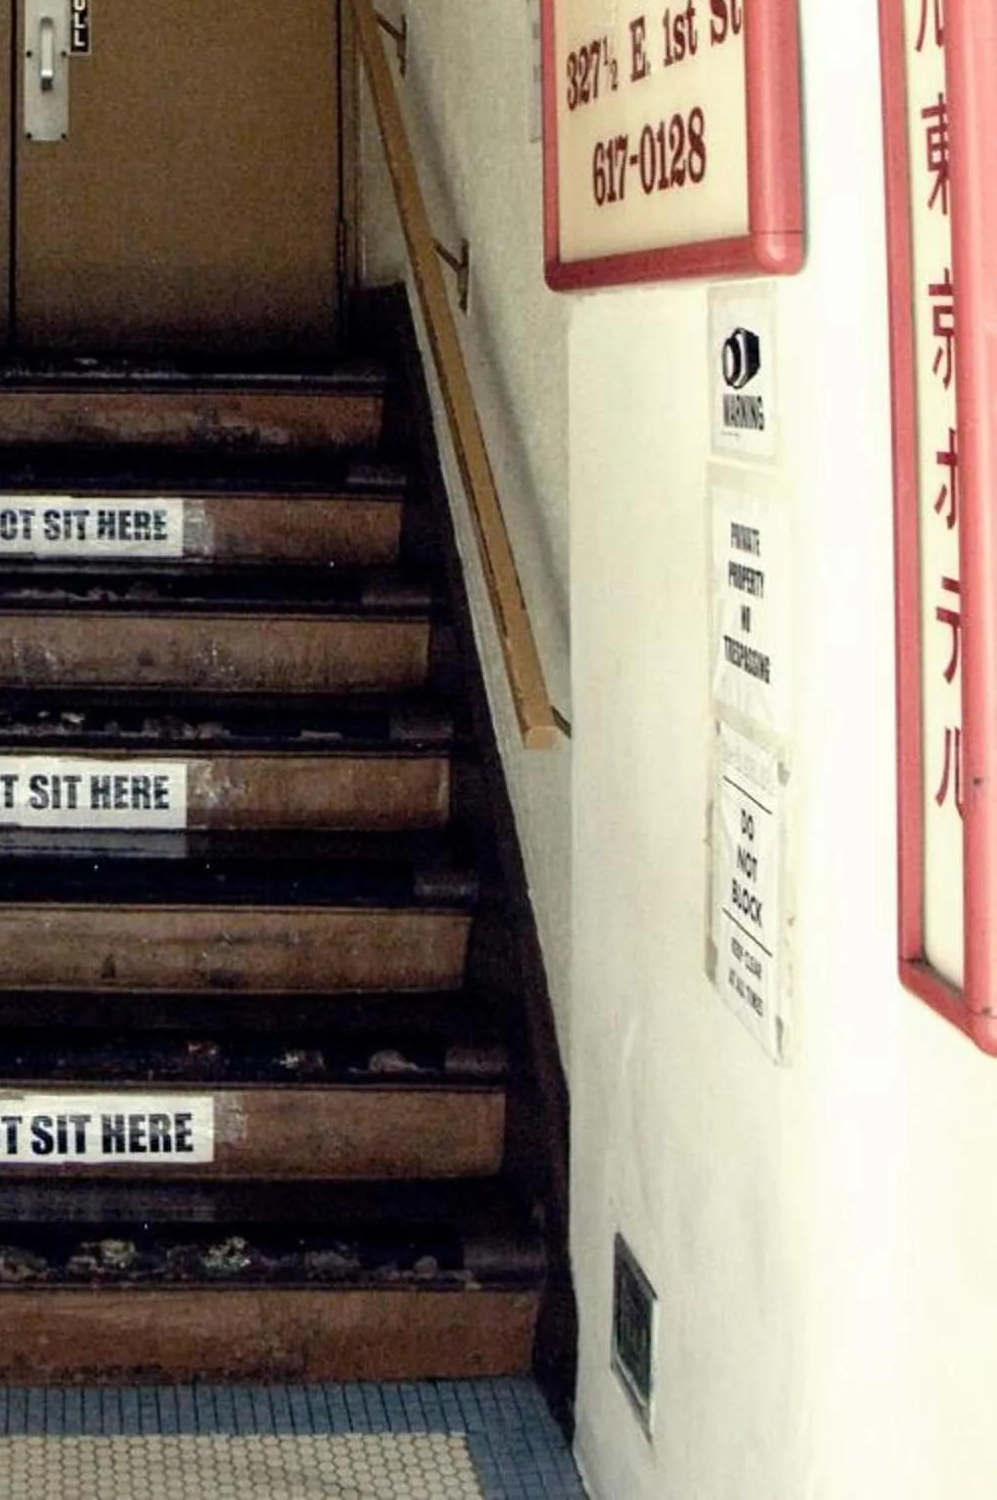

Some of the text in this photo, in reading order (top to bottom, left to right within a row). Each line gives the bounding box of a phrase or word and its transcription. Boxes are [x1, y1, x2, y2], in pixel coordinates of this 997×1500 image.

[592, 105, 707, 207] 617-0128
[723, 393, 765, 431] WARNING
[43, 509, 91, 541] SIT
[97, 510, 169, 541] HERE
[728, 560, 764, 599] PROPERTY
[723, 633, 771, 685] TRESPASSING
[29, 774, 82, 810] SIT
[90, 775, 170, 811] HERE
[740, 807, 754, 841] DO
[737, 844, 758, 884] NOT
[731, 878, 763, 928] BLOCK
[30, 1115, 92, 1156] SIT
[100, 1113, 194, 1154] HERE
